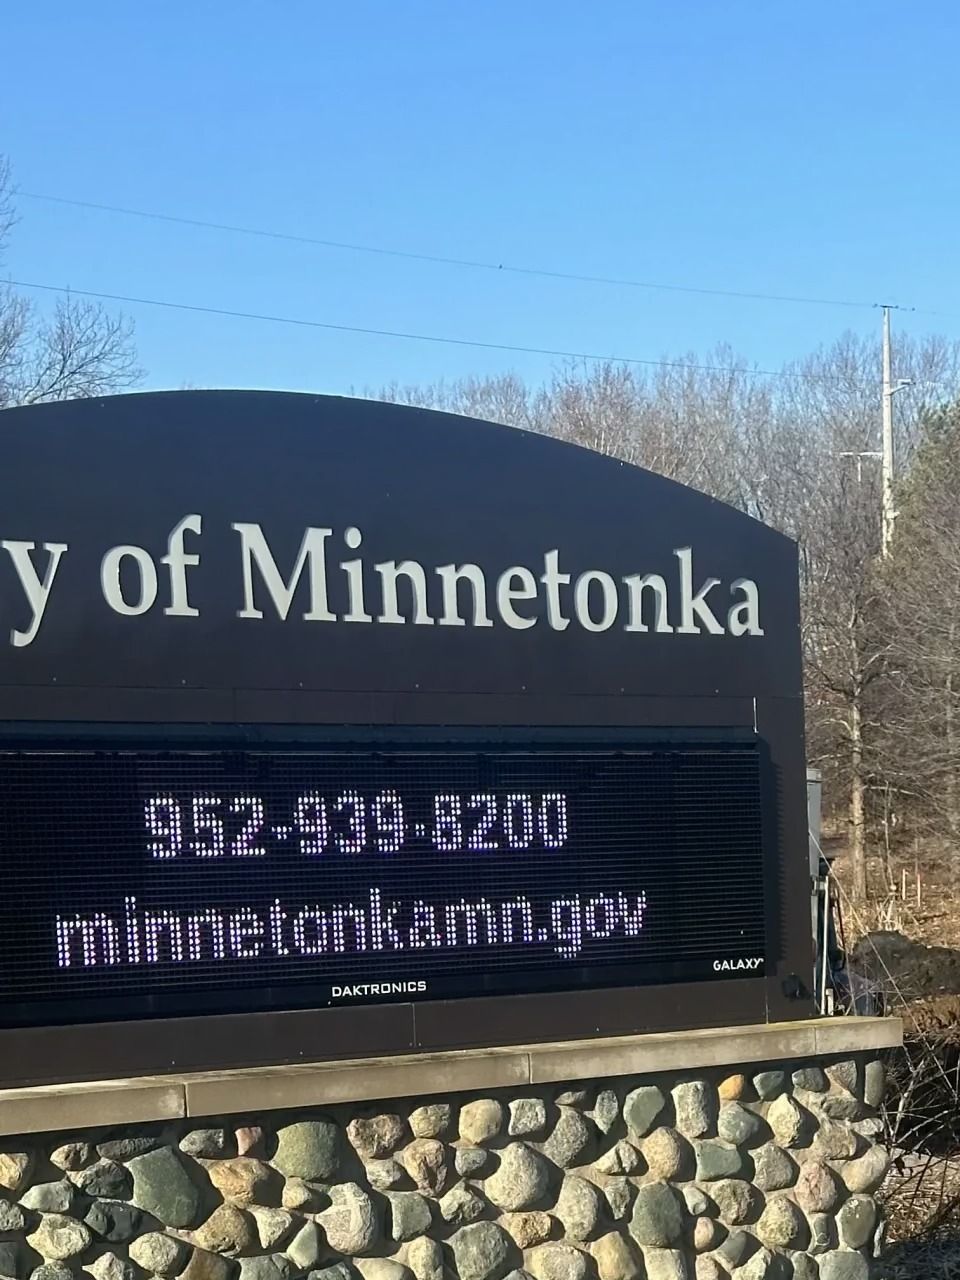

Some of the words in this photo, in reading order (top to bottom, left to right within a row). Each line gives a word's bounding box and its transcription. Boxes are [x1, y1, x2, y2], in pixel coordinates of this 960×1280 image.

[1, 539, 68, 649] y
[100, 514, 202, 617] of
[232, 522, 765, 637] Minnetonka
[144, 789, 568, 858] 952-939-8200
[56, 887, 647, 966] minnetonkamn.gov
[331, 980, 427, 998] DAKTRONICS
[712, 957, 764, 972] GALAXY
